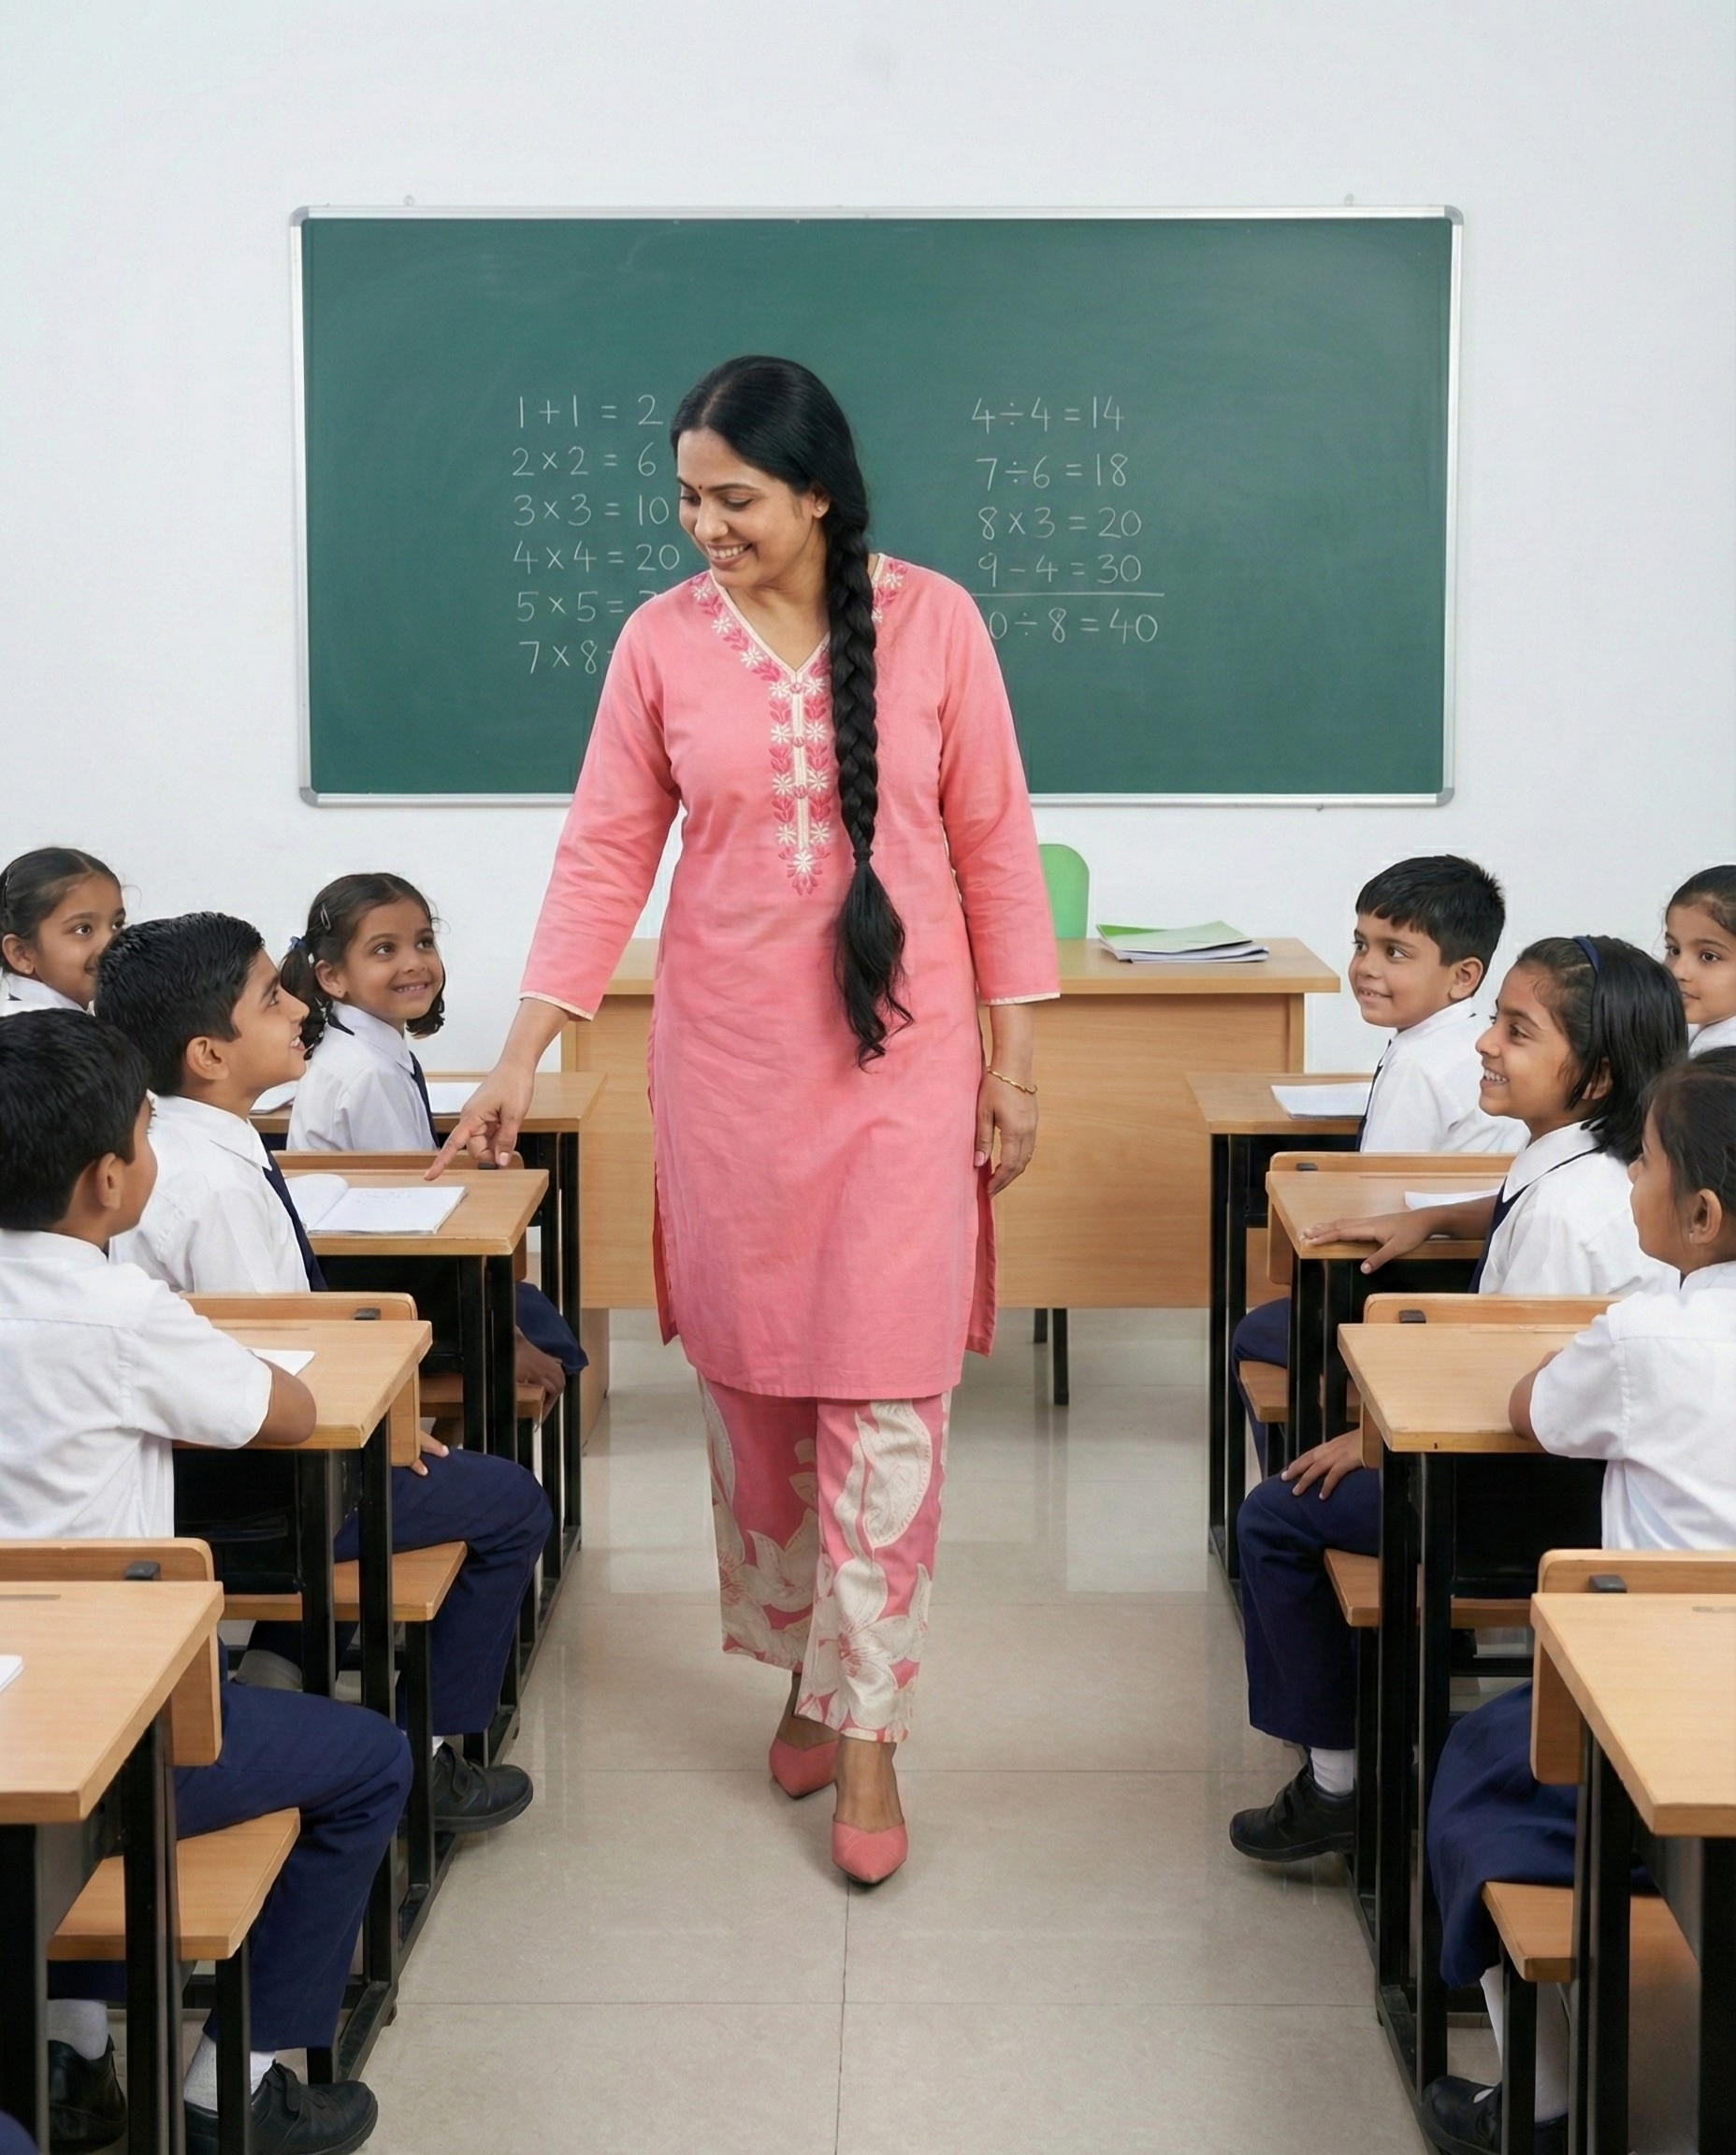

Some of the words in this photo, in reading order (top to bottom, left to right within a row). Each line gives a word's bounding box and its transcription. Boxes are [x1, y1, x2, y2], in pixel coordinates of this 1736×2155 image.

[638, 394, 664, 425] 2
[1093, 396, 1124, 432] 14
[638, 441, 656, 477] 6
[1096, 453, 1128, 487] 18
[639, 494, 670, 526] 10
[1097, 507, 1142, 539] 20
[635, 543, 680, 571] 20
[1096, 554, 1141, 584] 30
[1109, 608, 1158, 644] 40
